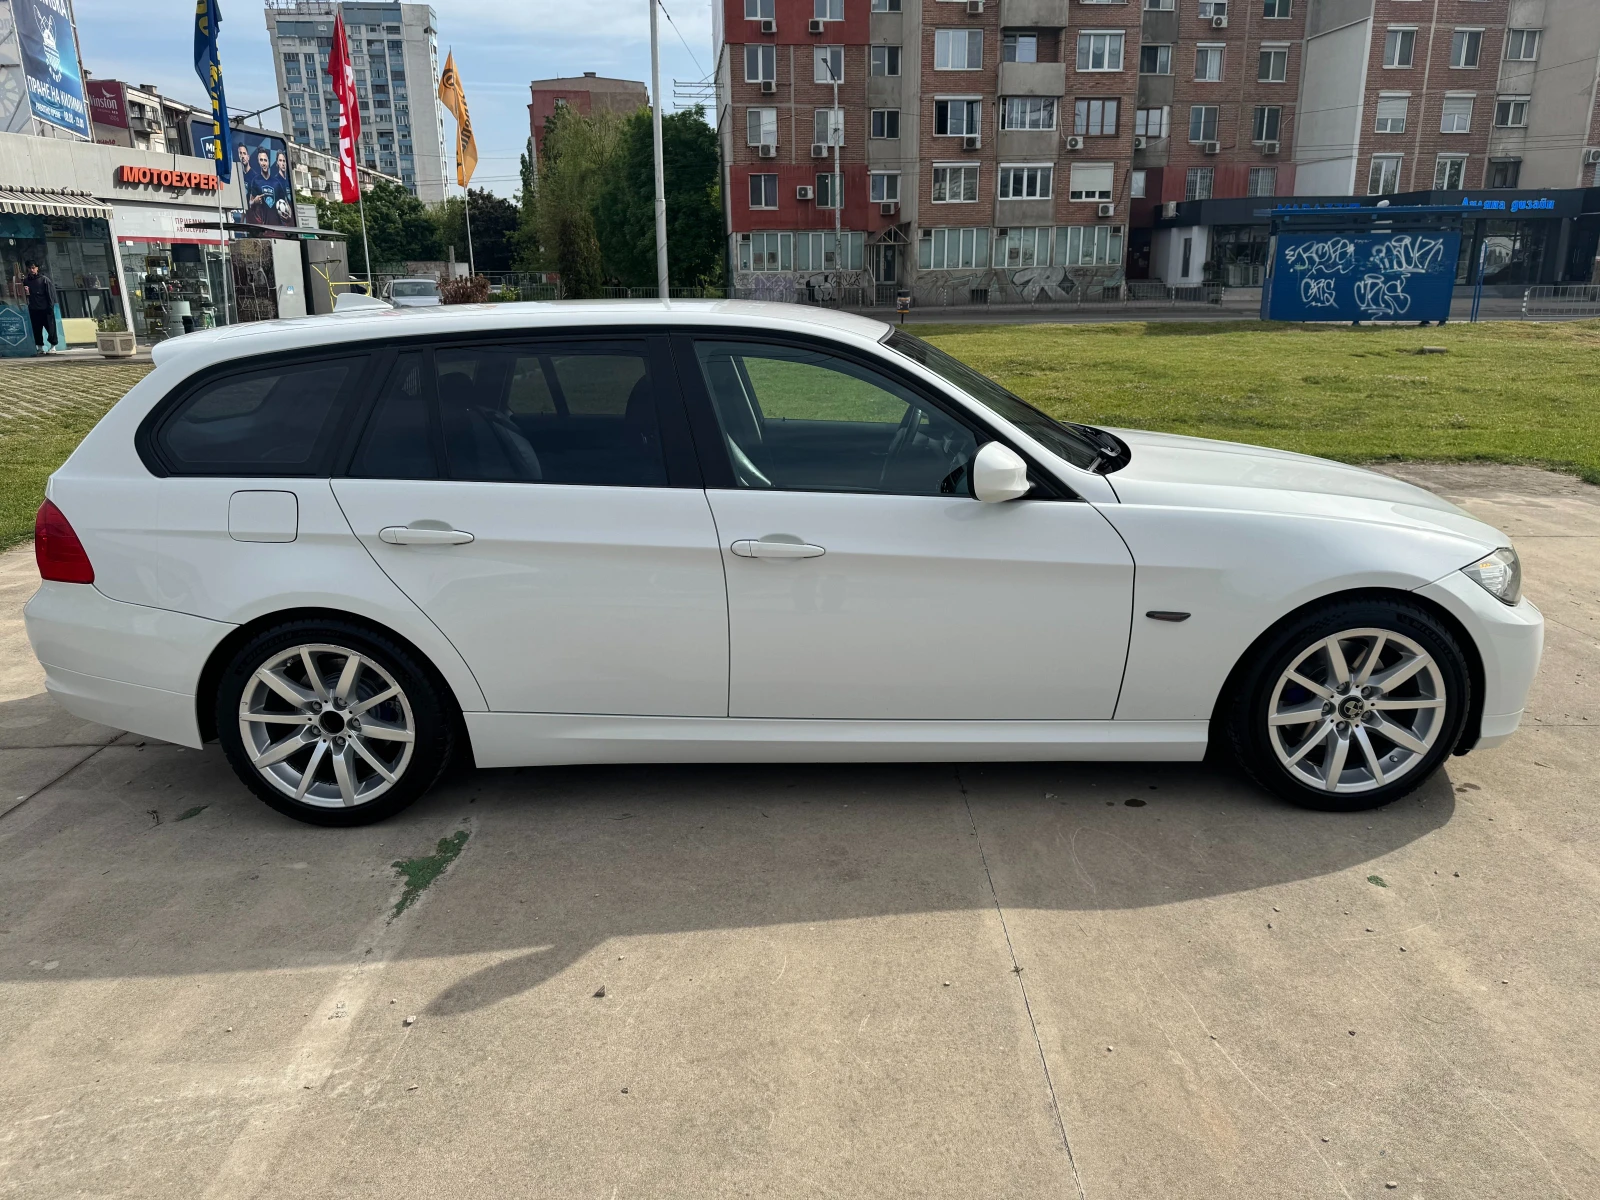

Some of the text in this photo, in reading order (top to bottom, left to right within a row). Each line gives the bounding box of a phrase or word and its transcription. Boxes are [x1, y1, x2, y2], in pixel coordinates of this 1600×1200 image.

[27, 74, 84, 115] ПРАНЕ НА КИЛИМИ
